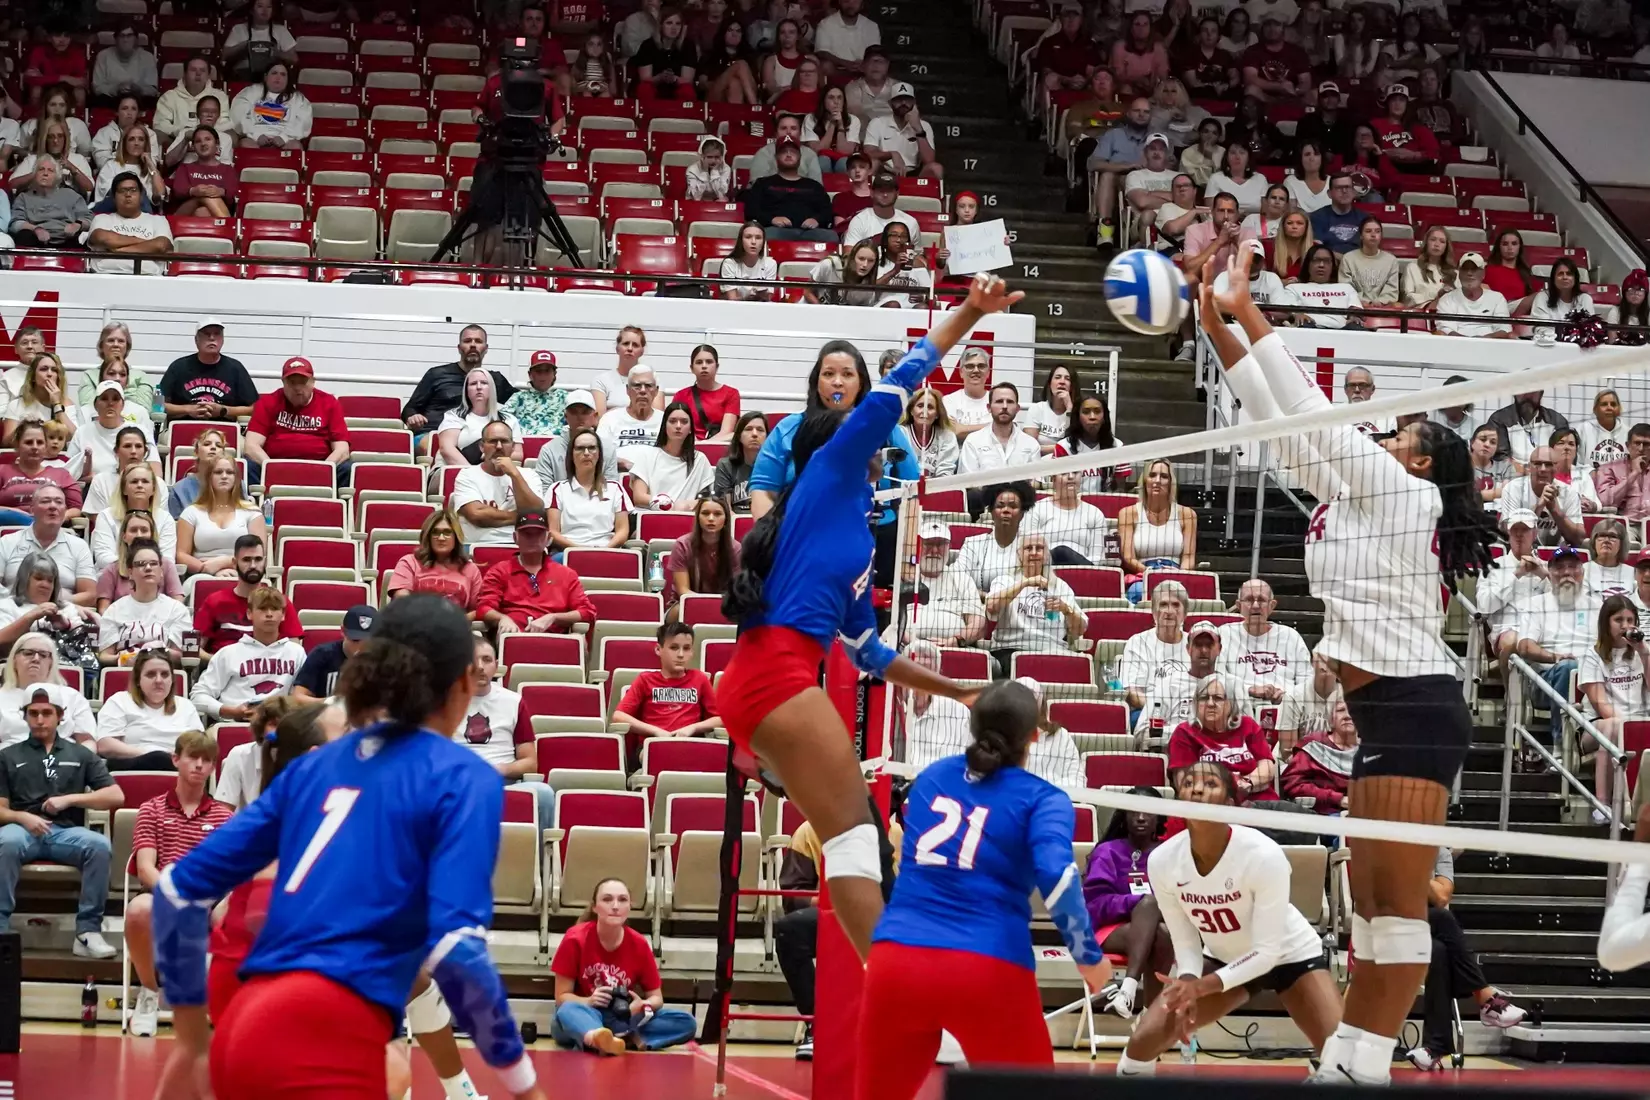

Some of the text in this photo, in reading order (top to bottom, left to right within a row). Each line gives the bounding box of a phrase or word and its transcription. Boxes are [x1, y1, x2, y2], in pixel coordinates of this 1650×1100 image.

[881, 7, 897, 16] 22
[897, 36, 910, 45] 21
[910, 65, 928, 75] 20
[899, 84, 908, 93] A
[932, 95, 946, 106] 19
[946, 126, 960, 137] 18
[783, 134, 794, 143] A
[963, 159, 978, 170] 17
[190, 171, 223, 180] RKANSAS
[983, 195, 997, 206] 16
[115, 225, 152, 238] RKANSAS
[1024, 265, 1040, 277] 14
[1048, 304, 1063, 316] 13
[184, 377, 232, 395] ARKANSAS
[189, 386, 205, 396] TRACK
[211, 387, 225, 398] FIELD
[1093, 380, 1109, 394] 11
[277, 411, 322, 429] ARKANSAS
[620, 428, 645, 437] CBU
[239, 657, 295, 678] ARKANSAS
[1238, 655, 1288, 668] ARKANSAS
[652, 686, 699, 704] ARKANSAS
[914, 794, 990, 871] 21
[283, 786, 362, 894] 1
[1181, 890, 1242, 906] ARKANSAS
[1191, 907, 1242, 935] 30
